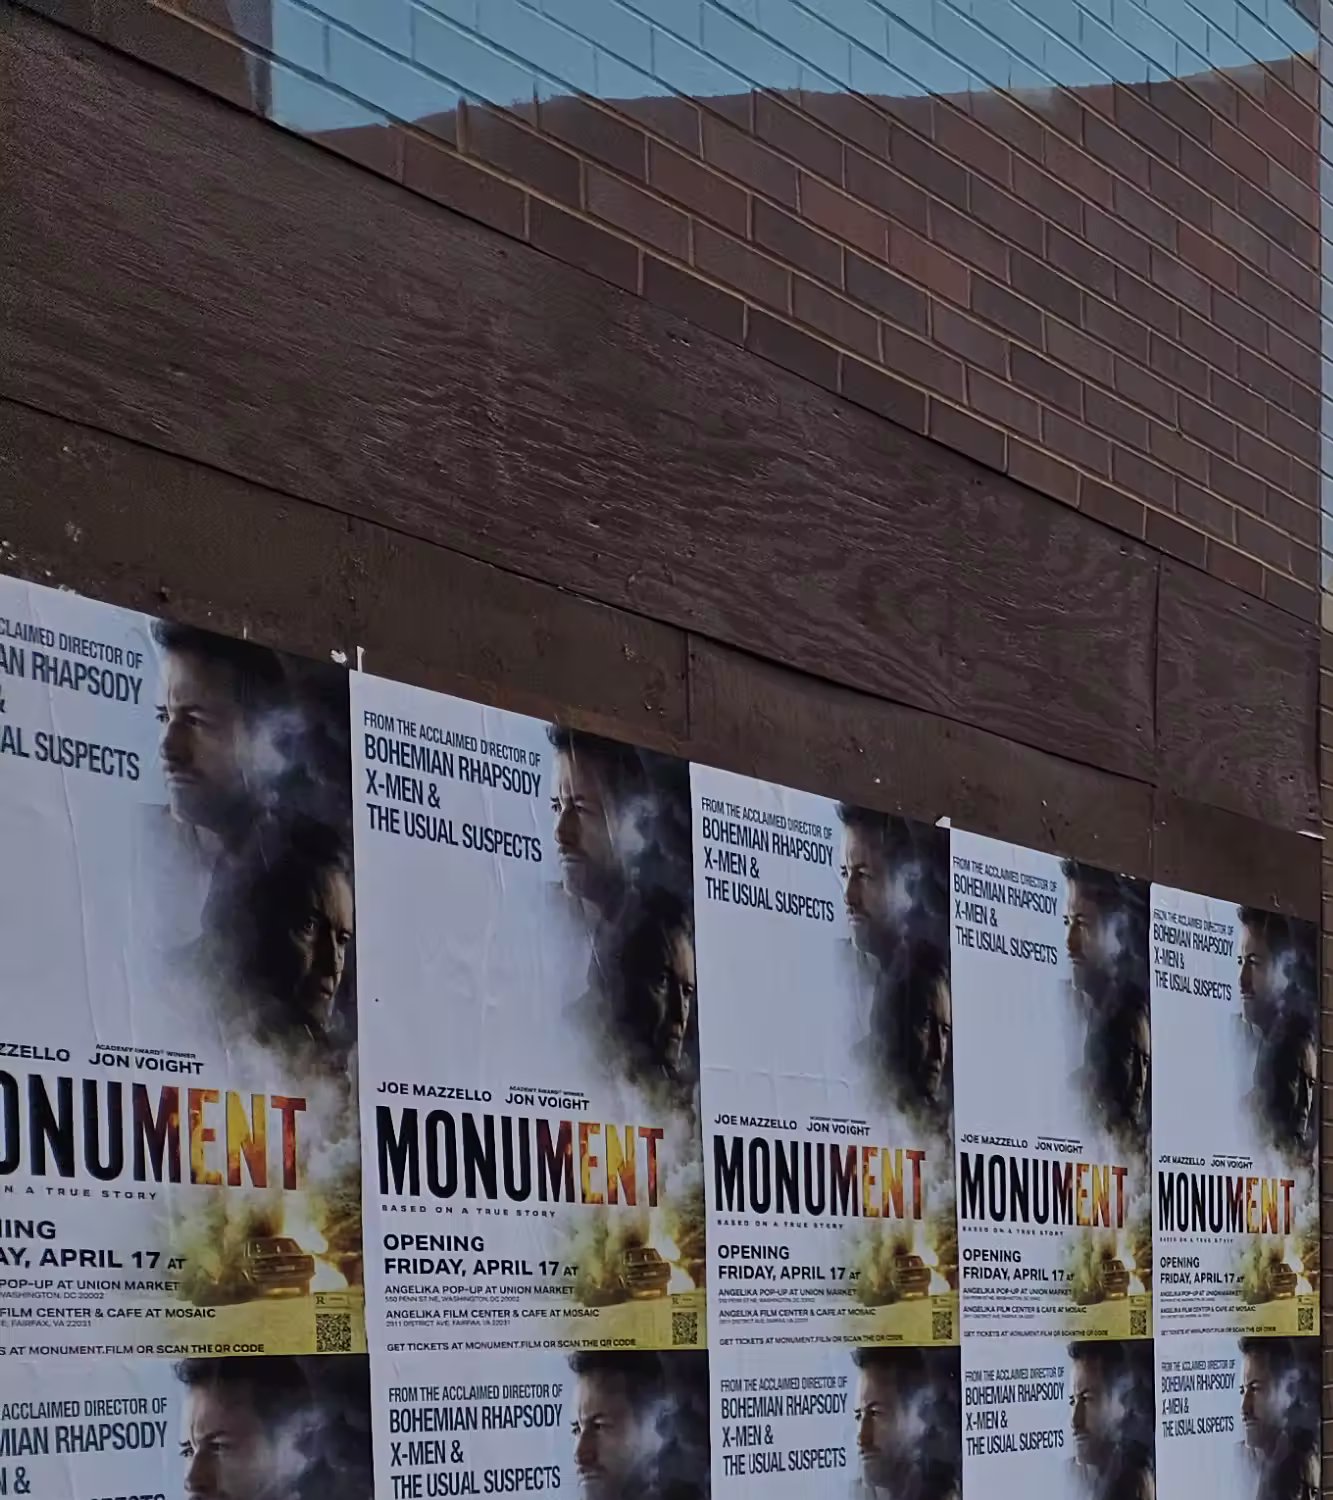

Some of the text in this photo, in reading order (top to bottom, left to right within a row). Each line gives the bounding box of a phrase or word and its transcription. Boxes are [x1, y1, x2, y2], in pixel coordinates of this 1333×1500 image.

[59, 632, 143, 669] DIRECTOR OF
[32, 651, 142, 704] RHAPSODY
[364, 711, 541, 767] FROM THE ACCLAIMED DIRECTOR OF
[35, 731, 140, 781] SUSPECTS
[364, 733, 541, 798] BOHEMIAN RHAPSODY
[366, 768, 441, 809] X-MEN &
[366, 803, 542, 862] THE USUAL SUSPECTS
[702, 816, 833, 867] BOHEMIAN RHAPSODY
[704, 846, 760, 879] X-MEN &
[705, 876, 834, 922] THE USUAL SUSPECTS
[89, 1053, 204, 1075] JON VOIGHT
[377, 1081, 590, 1111] JOE MAZZELLO JON VOIGHT
[714, 1114, 738, 1125] JOE
[740, 1116, 797, 1130] MAZZELLO
[806, 1122, 829, 1133] JON
[832, 1123, 870, 1136] VOIGHT
[376, 1105, 664, 1207] MONUMENT
[713, 1135, 926, 1219] MONUMENT
[960, 1151, 1128, 1229] MONUMENT
[1158, 1171, 1295, 1235] MONUMENT
[383, 1234, 484, 1252] OPENING
[717, 1244, 790, 1260] OPENING
[962, 1248, 1022, 1263] OPENING
[40, 1248, 160, 1269] APRIL 17
[384, 1258, 578, 1276] FRIDAY, APRIL 17 AT
[1160, 1256, 1200, 1268] OPENING
[718, 1265, 846, 1282] FRIDAY, APRIL 17
[963, 1266, 1065, 1282] FRIDAY, APRIL 17
[1160, 1272, 1235, 1285] FRIDAY, APRIL 17
[389, 1384, 562, 1402] FROM THE ACCLAIMED DIRECTOR OF
[721, 1393, 847, 1419] BOHEMIAN RHAPSODY
[1, 1397, 167, 1421] ACCLAIMED DIRECTOR OF
[390, 1404, 562, 1433] BOHEMIAN RHAPSODY
[55, 1421, 167, 1454] RHAPSODY
[722, 1424, 774, 1448] X-MEN &
[390, 1439, 464, 1467] X-MEN &
[723, 1446, 846, 1476] THE USUAL SUSPECTS
[13, 1466, 31, 1494] &
[391, 1465, 561, 1500] THE USUAL SUSPECTS
